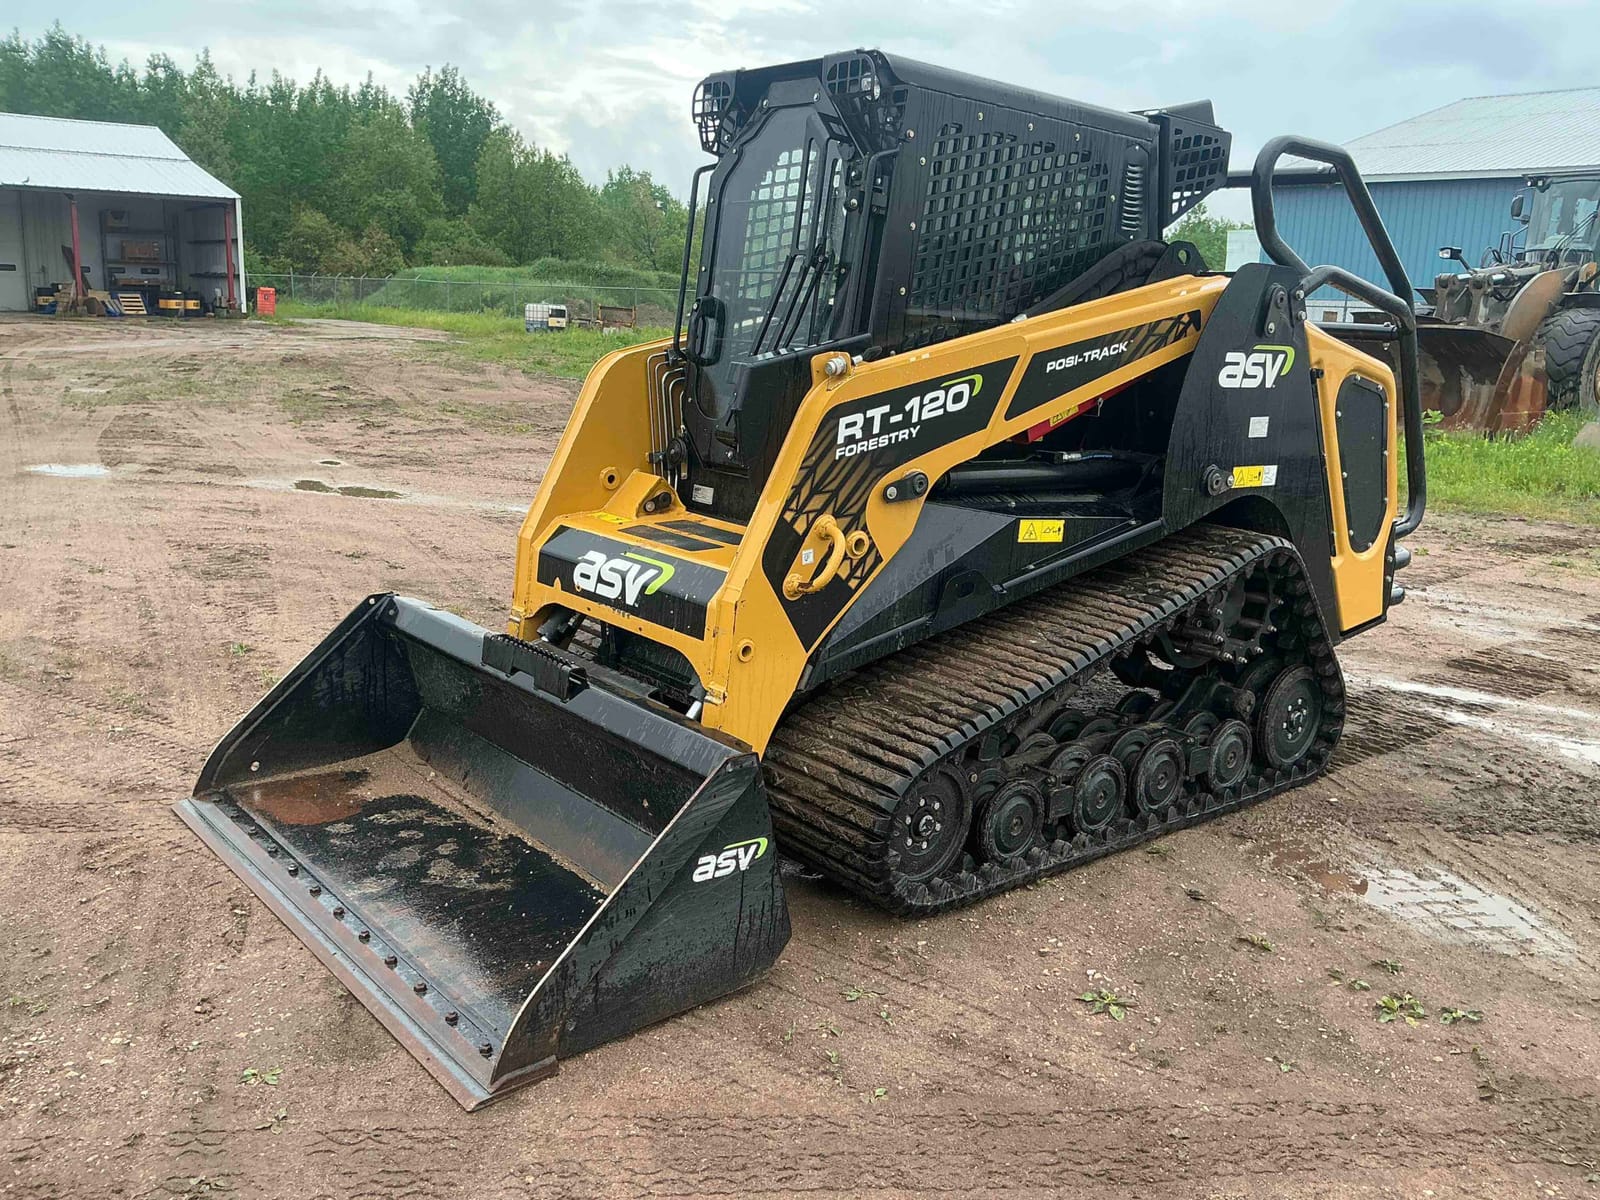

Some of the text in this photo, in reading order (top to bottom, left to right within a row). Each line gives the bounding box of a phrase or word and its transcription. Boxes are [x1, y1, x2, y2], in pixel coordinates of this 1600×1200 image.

[1046, 340, 1128, 373] POSI-TRACK
[836, 382, 971, 445] RT-120
[835, 424, 921, 461] FORESTRY
